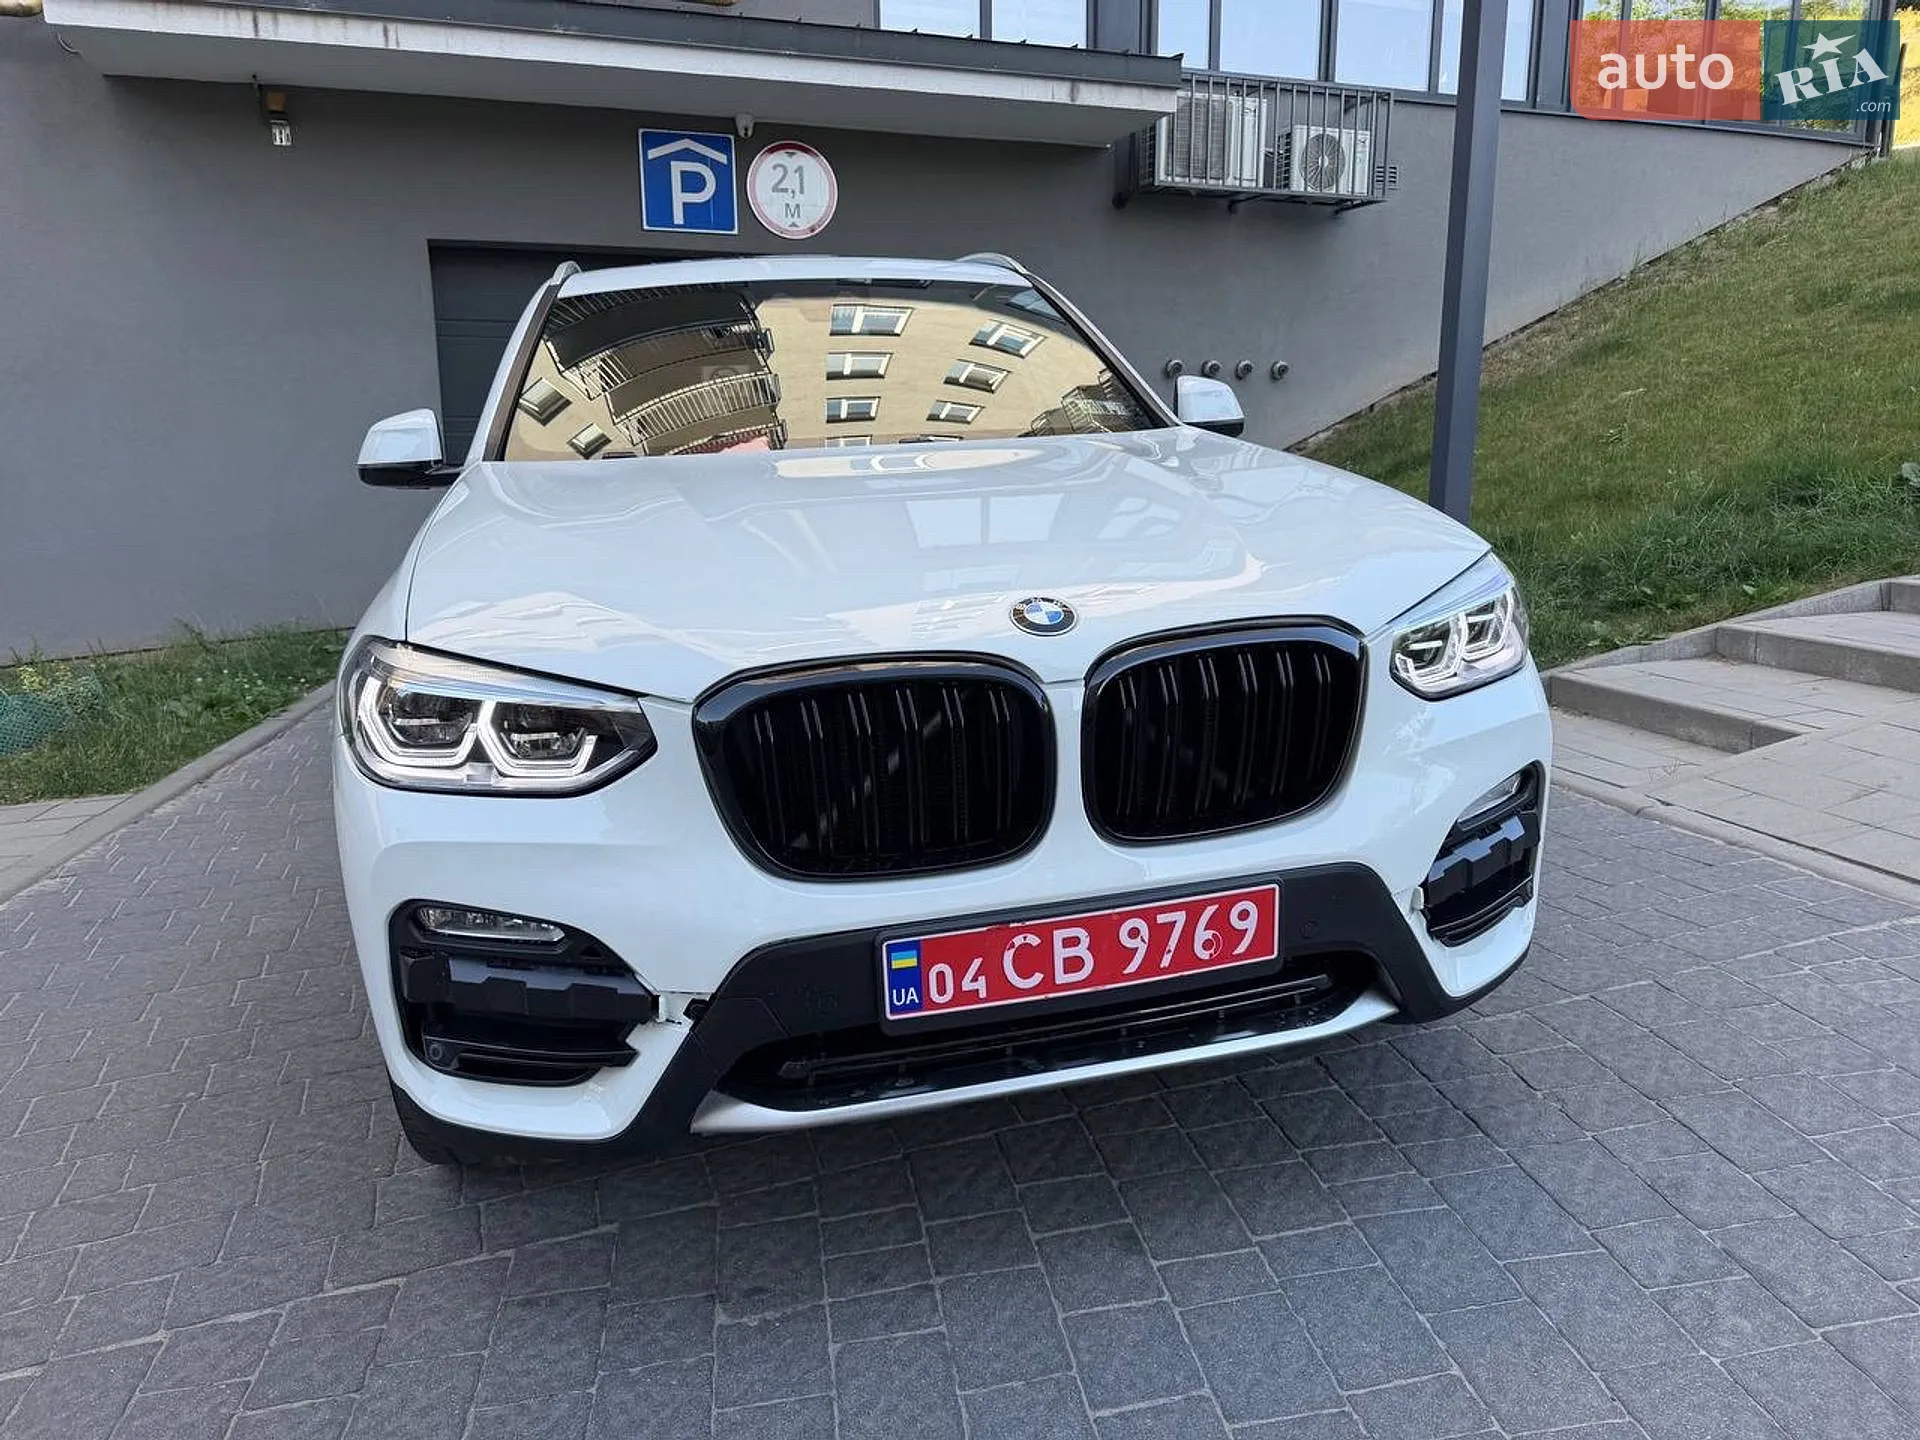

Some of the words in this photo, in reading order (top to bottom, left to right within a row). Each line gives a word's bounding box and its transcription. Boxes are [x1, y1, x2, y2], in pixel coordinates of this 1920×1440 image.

[671, 160, 716, 224] P
[771, 163, 805, 199] 2,1
[928, 957, 987, 1003] 04
[1118, 899, 1259, 976] 9769
[892, 987, 919, 1007] UA
